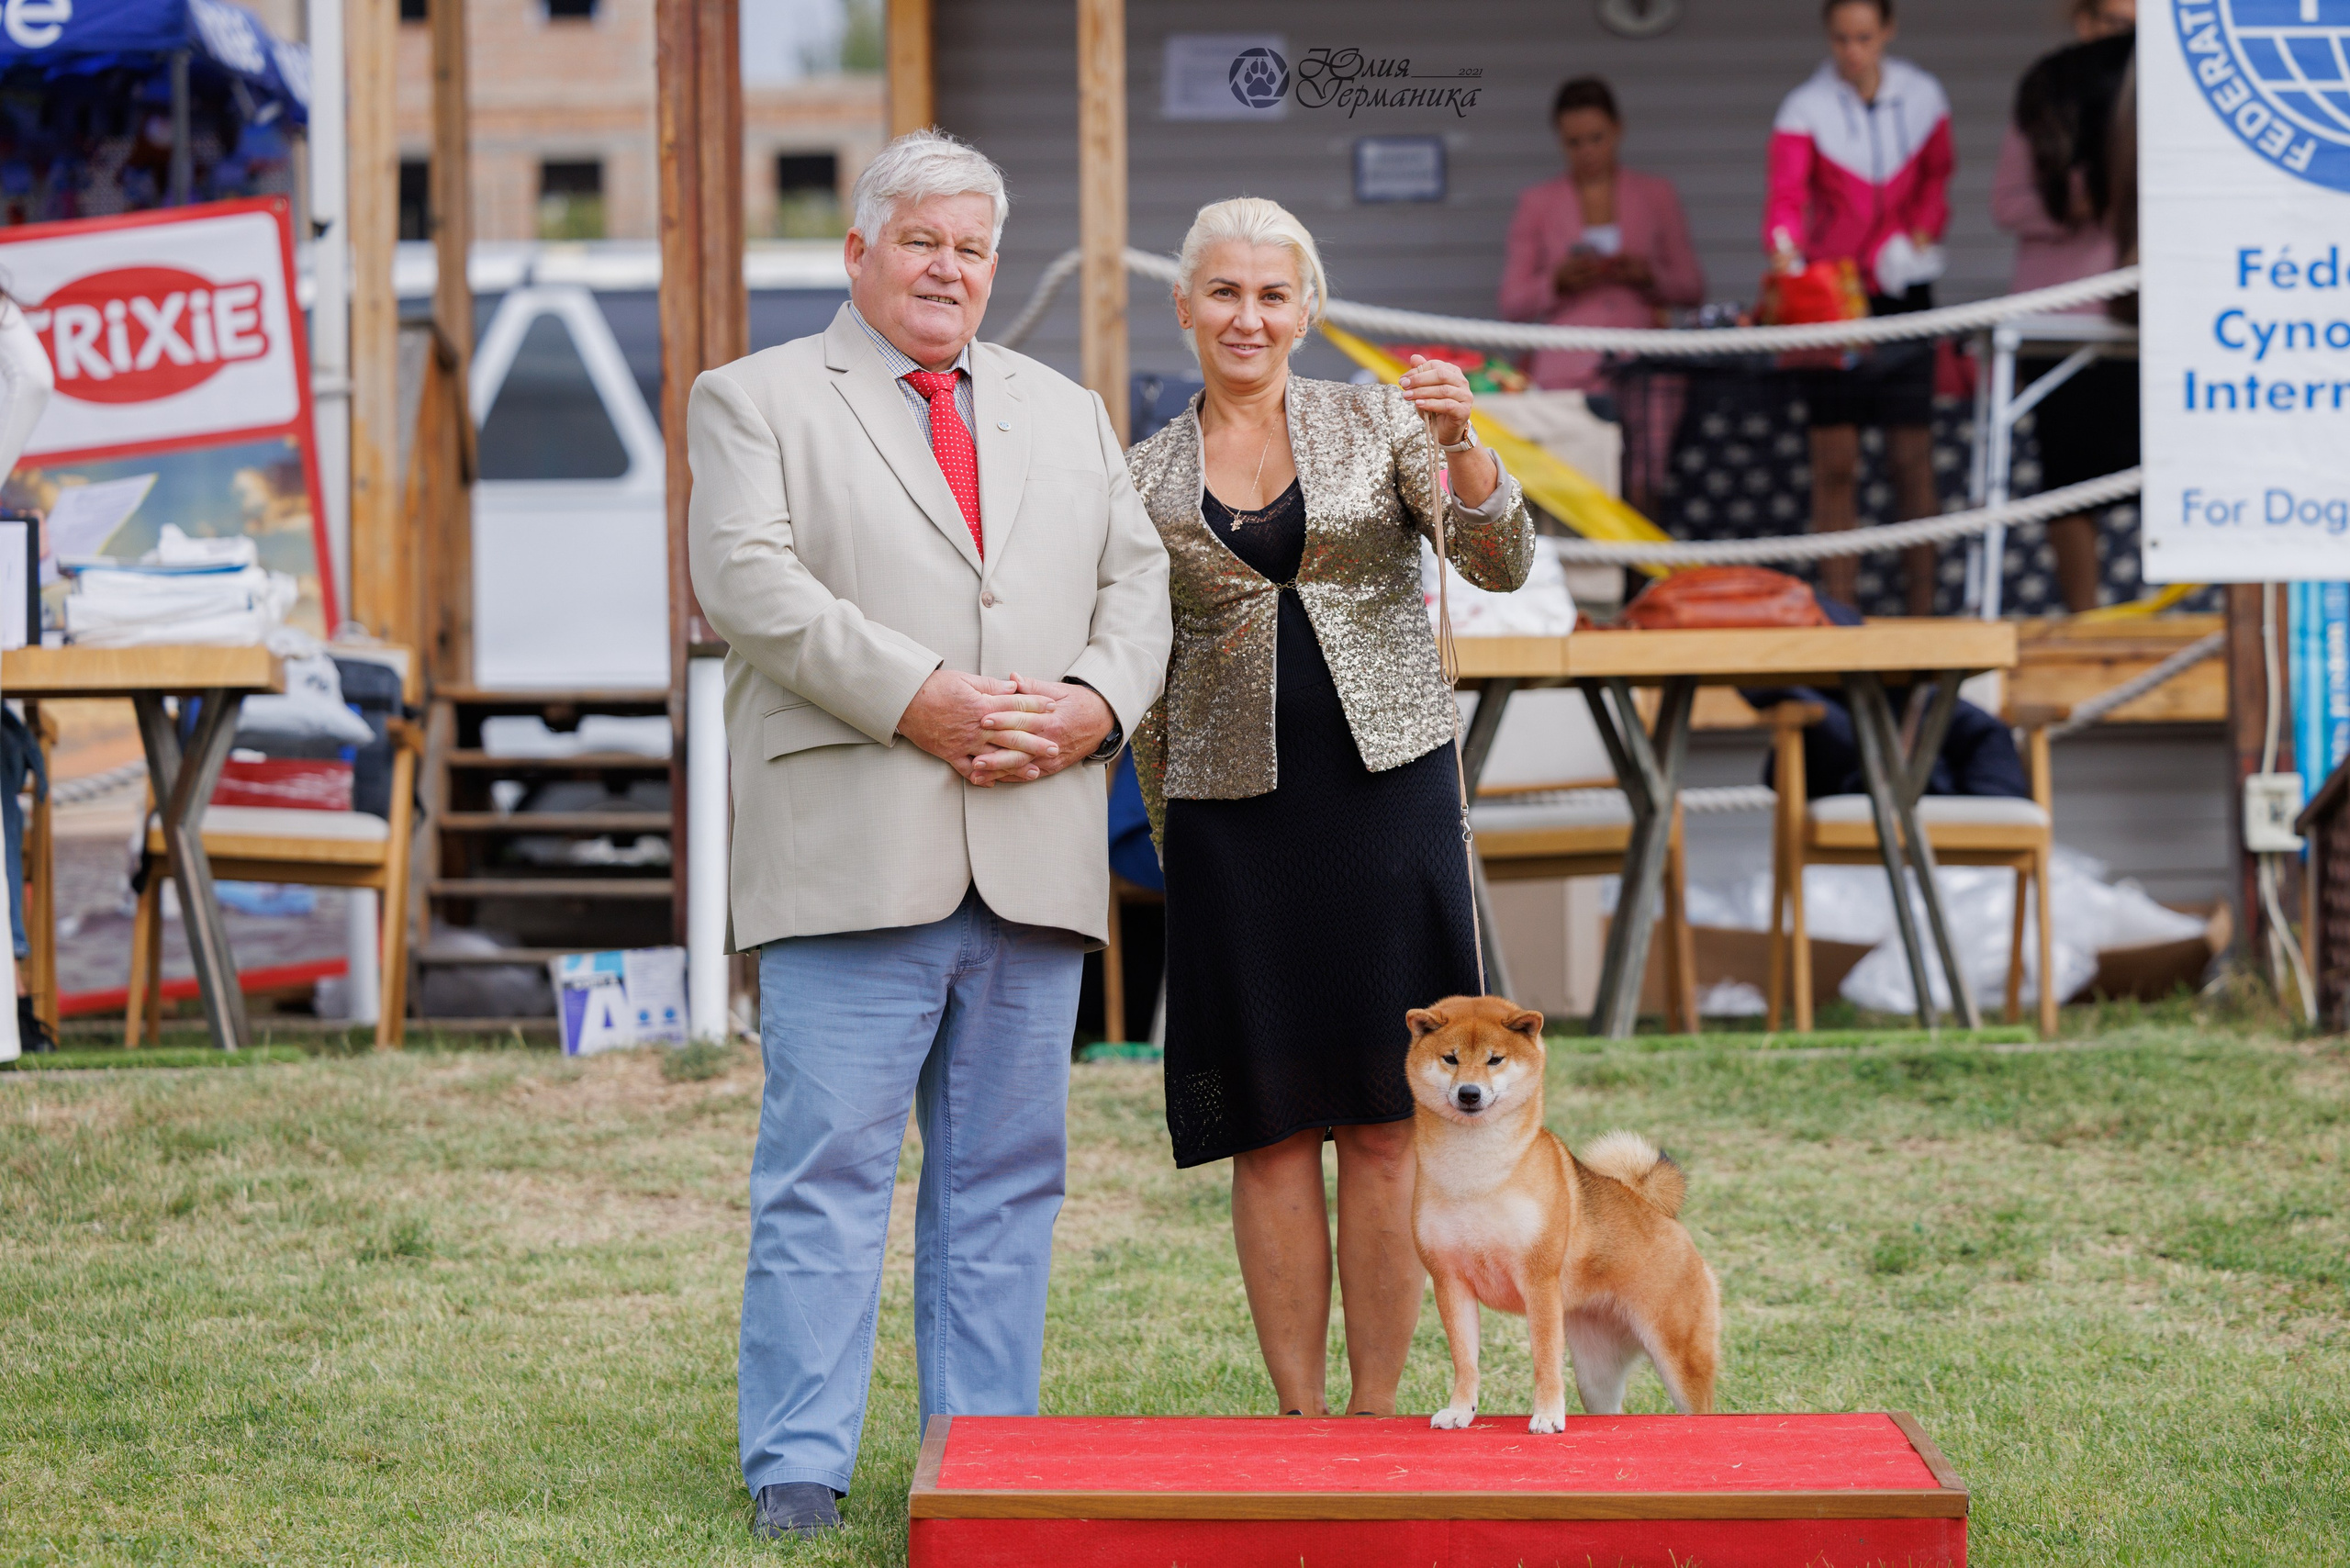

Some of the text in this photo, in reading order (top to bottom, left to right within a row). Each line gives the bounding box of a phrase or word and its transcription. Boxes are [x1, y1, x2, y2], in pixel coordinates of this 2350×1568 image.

[2237, 243, 2350, 289] Féd
[2213, 308, 2350, 362] Cyno
[2182, 487, 2349, 536] For Dog
